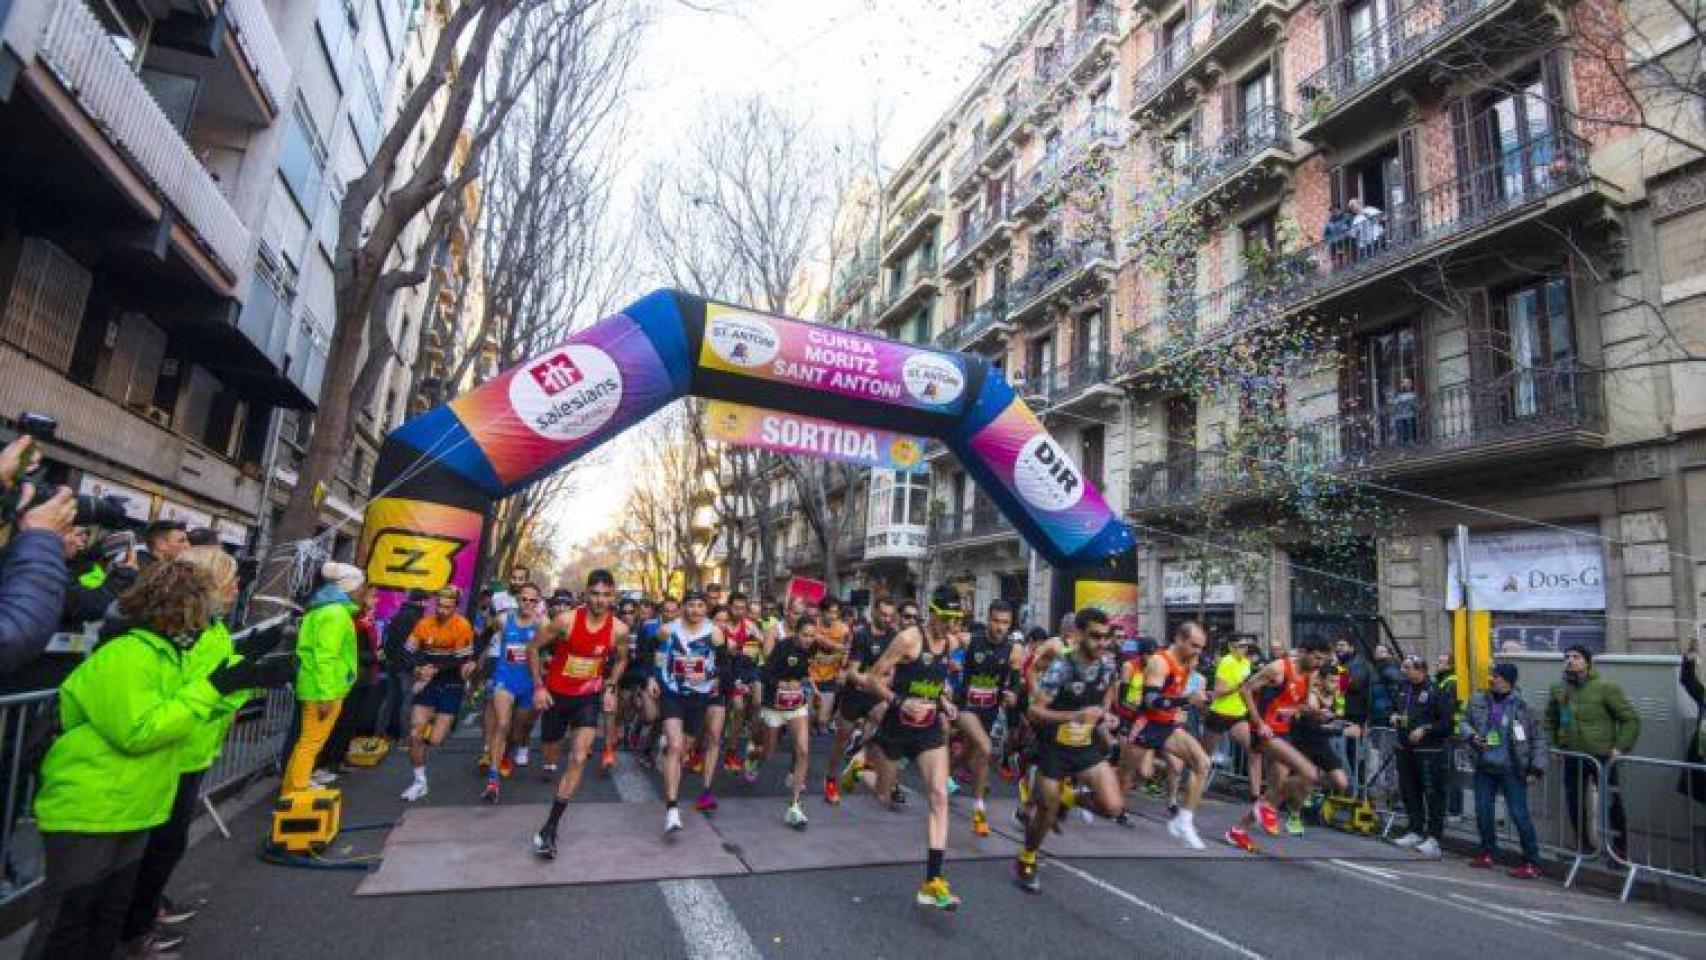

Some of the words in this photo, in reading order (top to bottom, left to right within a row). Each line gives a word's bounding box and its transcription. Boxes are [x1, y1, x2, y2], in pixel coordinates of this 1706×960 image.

[773, 359, 827, 384] SANT
[830, 371, 900, 399] ANTONI
[805, 344, 878, 375] MORITZ
[536, 378, 617, 428] salesians
[761, 415, 879, 461] SORTIDA
